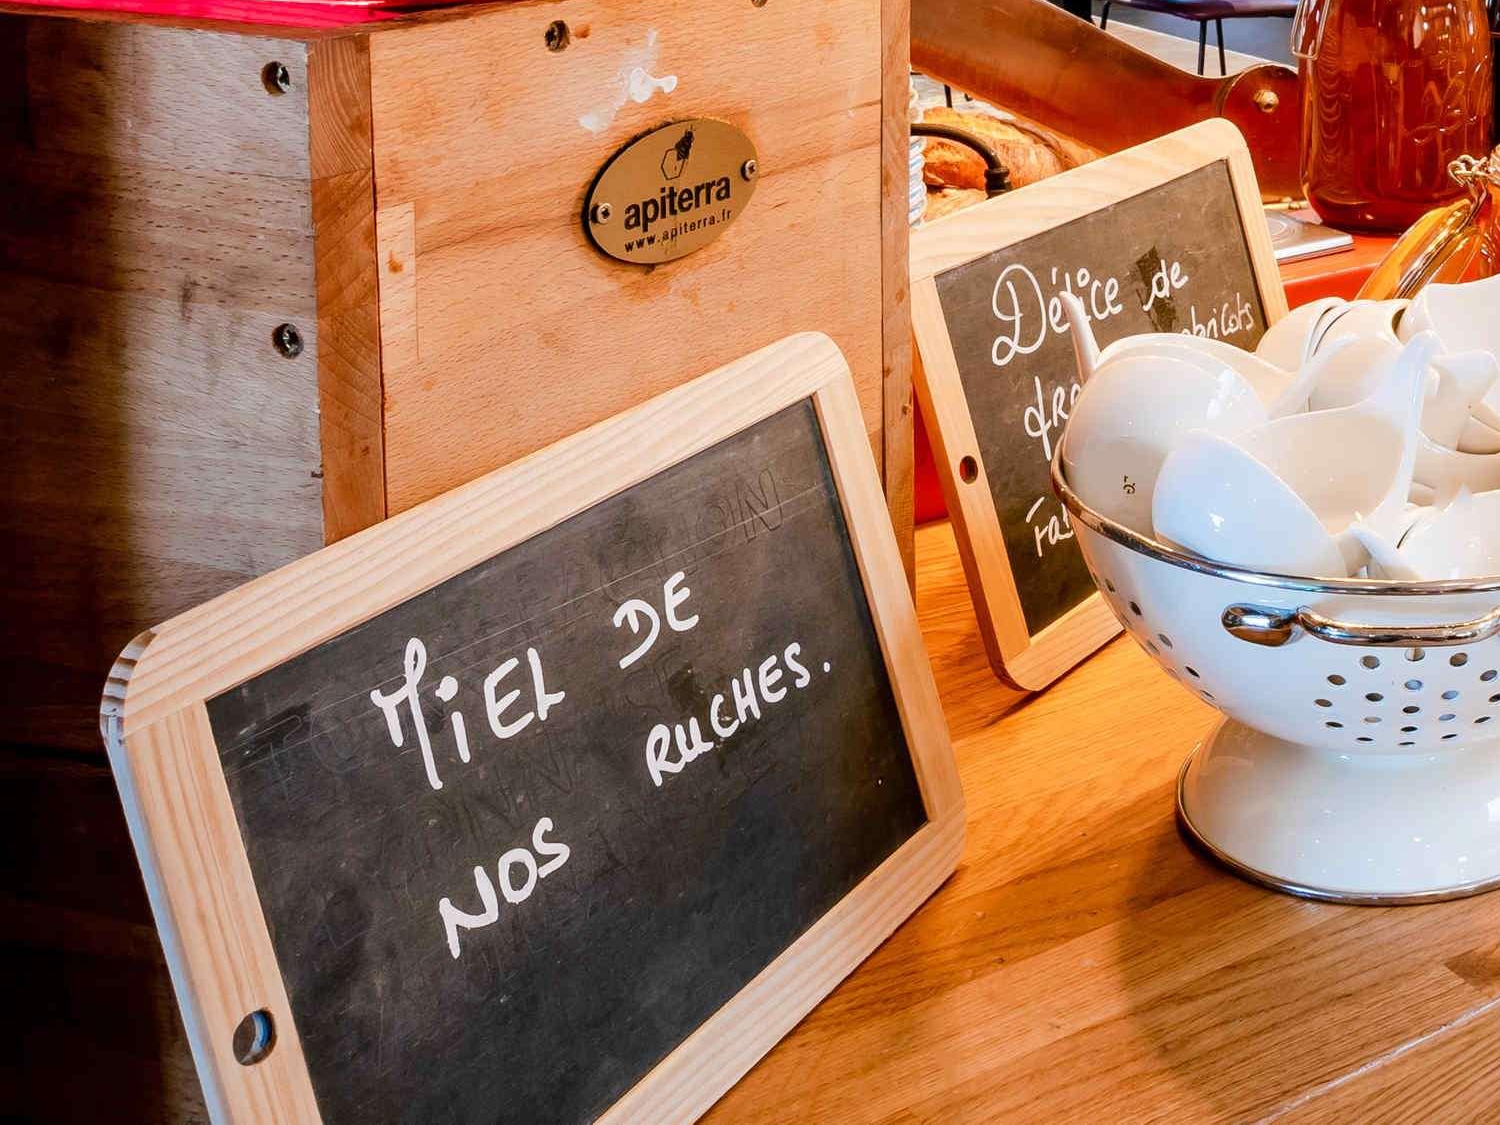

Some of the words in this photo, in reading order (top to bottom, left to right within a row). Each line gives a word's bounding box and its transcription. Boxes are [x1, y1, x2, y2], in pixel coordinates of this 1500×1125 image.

[624, 177, 731, 232] apiterra
[624, 208, 733, 253] www.apiterra.fr
[1142, 258, 1189, 312] de
[613, 570, 701, 671] DE
[439, 816, 571, 960] NOS
[644, 642, 832, 786] RUCHES.
